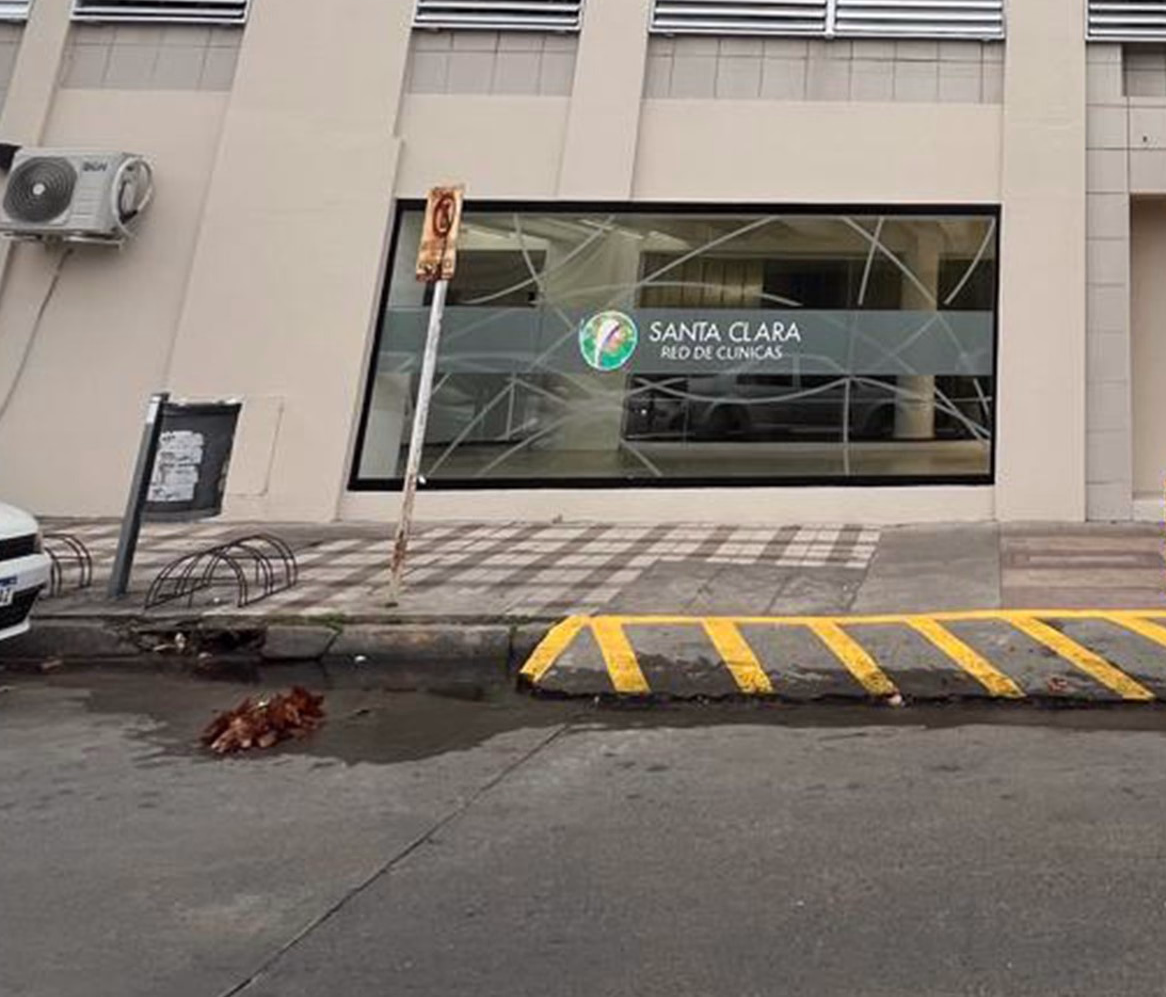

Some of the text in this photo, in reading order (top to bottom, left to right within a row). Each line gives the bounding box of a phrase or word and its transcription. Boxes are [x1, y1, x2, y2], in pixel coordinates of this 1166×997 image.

[649, 320, 801, 343] SANTA CLARA
[660, 345, 691, 360] RED
[693, 345, 713, 360] DE
